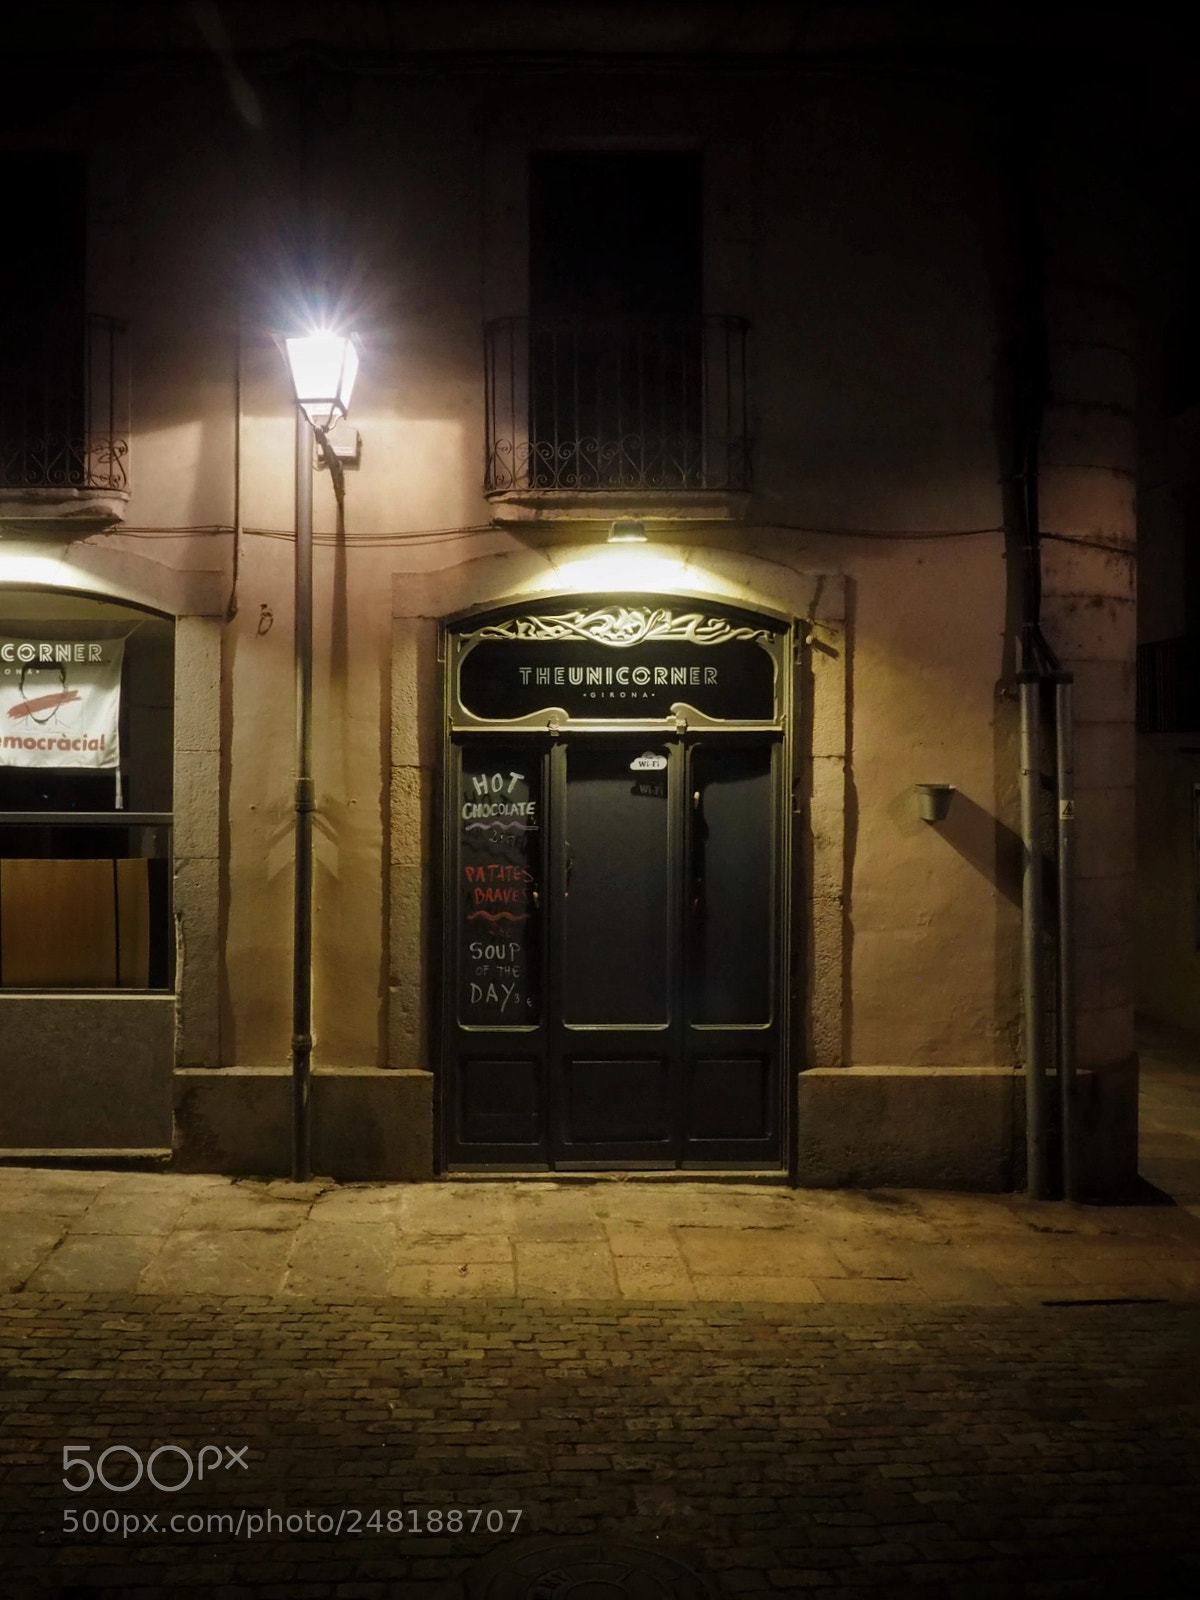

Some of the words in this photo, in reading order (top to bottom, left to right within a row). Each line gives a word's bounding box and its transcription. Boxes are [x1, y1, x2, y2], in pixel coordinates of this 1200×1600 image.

[0, 733, 105, 751] mocràcia!
[472, 772, 525, 795] HOT
[462, 801, 536, 819] CHOCOLATE
[469, 941, 520, 961] SOUP
[475, 965, 490, 976] OF
[496, 965, 520, 977] THE
[470, 982, 515, 1012] DAY
